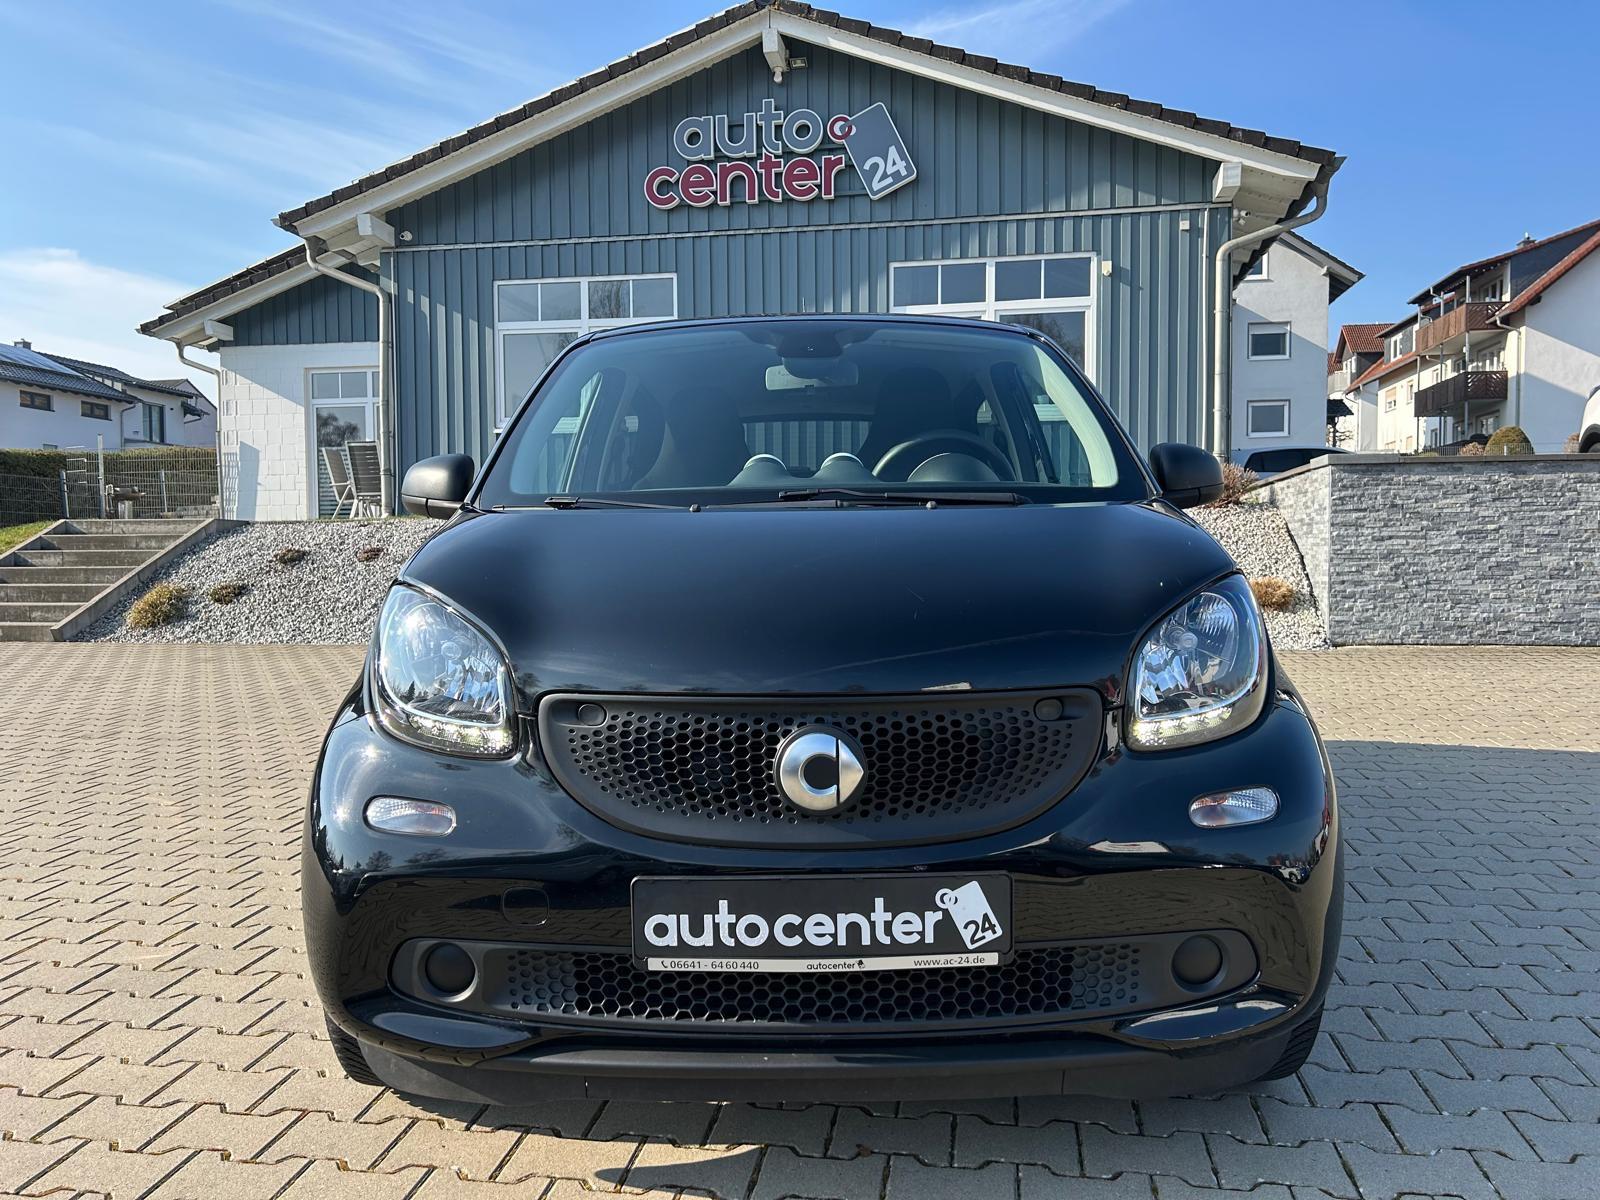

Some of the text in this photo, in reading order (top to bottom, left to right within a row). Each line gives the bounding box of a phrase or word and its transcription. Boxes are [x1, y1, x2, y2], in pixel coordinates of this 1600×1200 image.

[673, 98, 823, 161] auto
[644, 147, 845, 210] center
[863, 144, 907, 192] 24
[963, 912, 997, 946] 24
[806, 961, 856, 971] autocenter
[913, 955, 985, 967] www.ac-24.de
